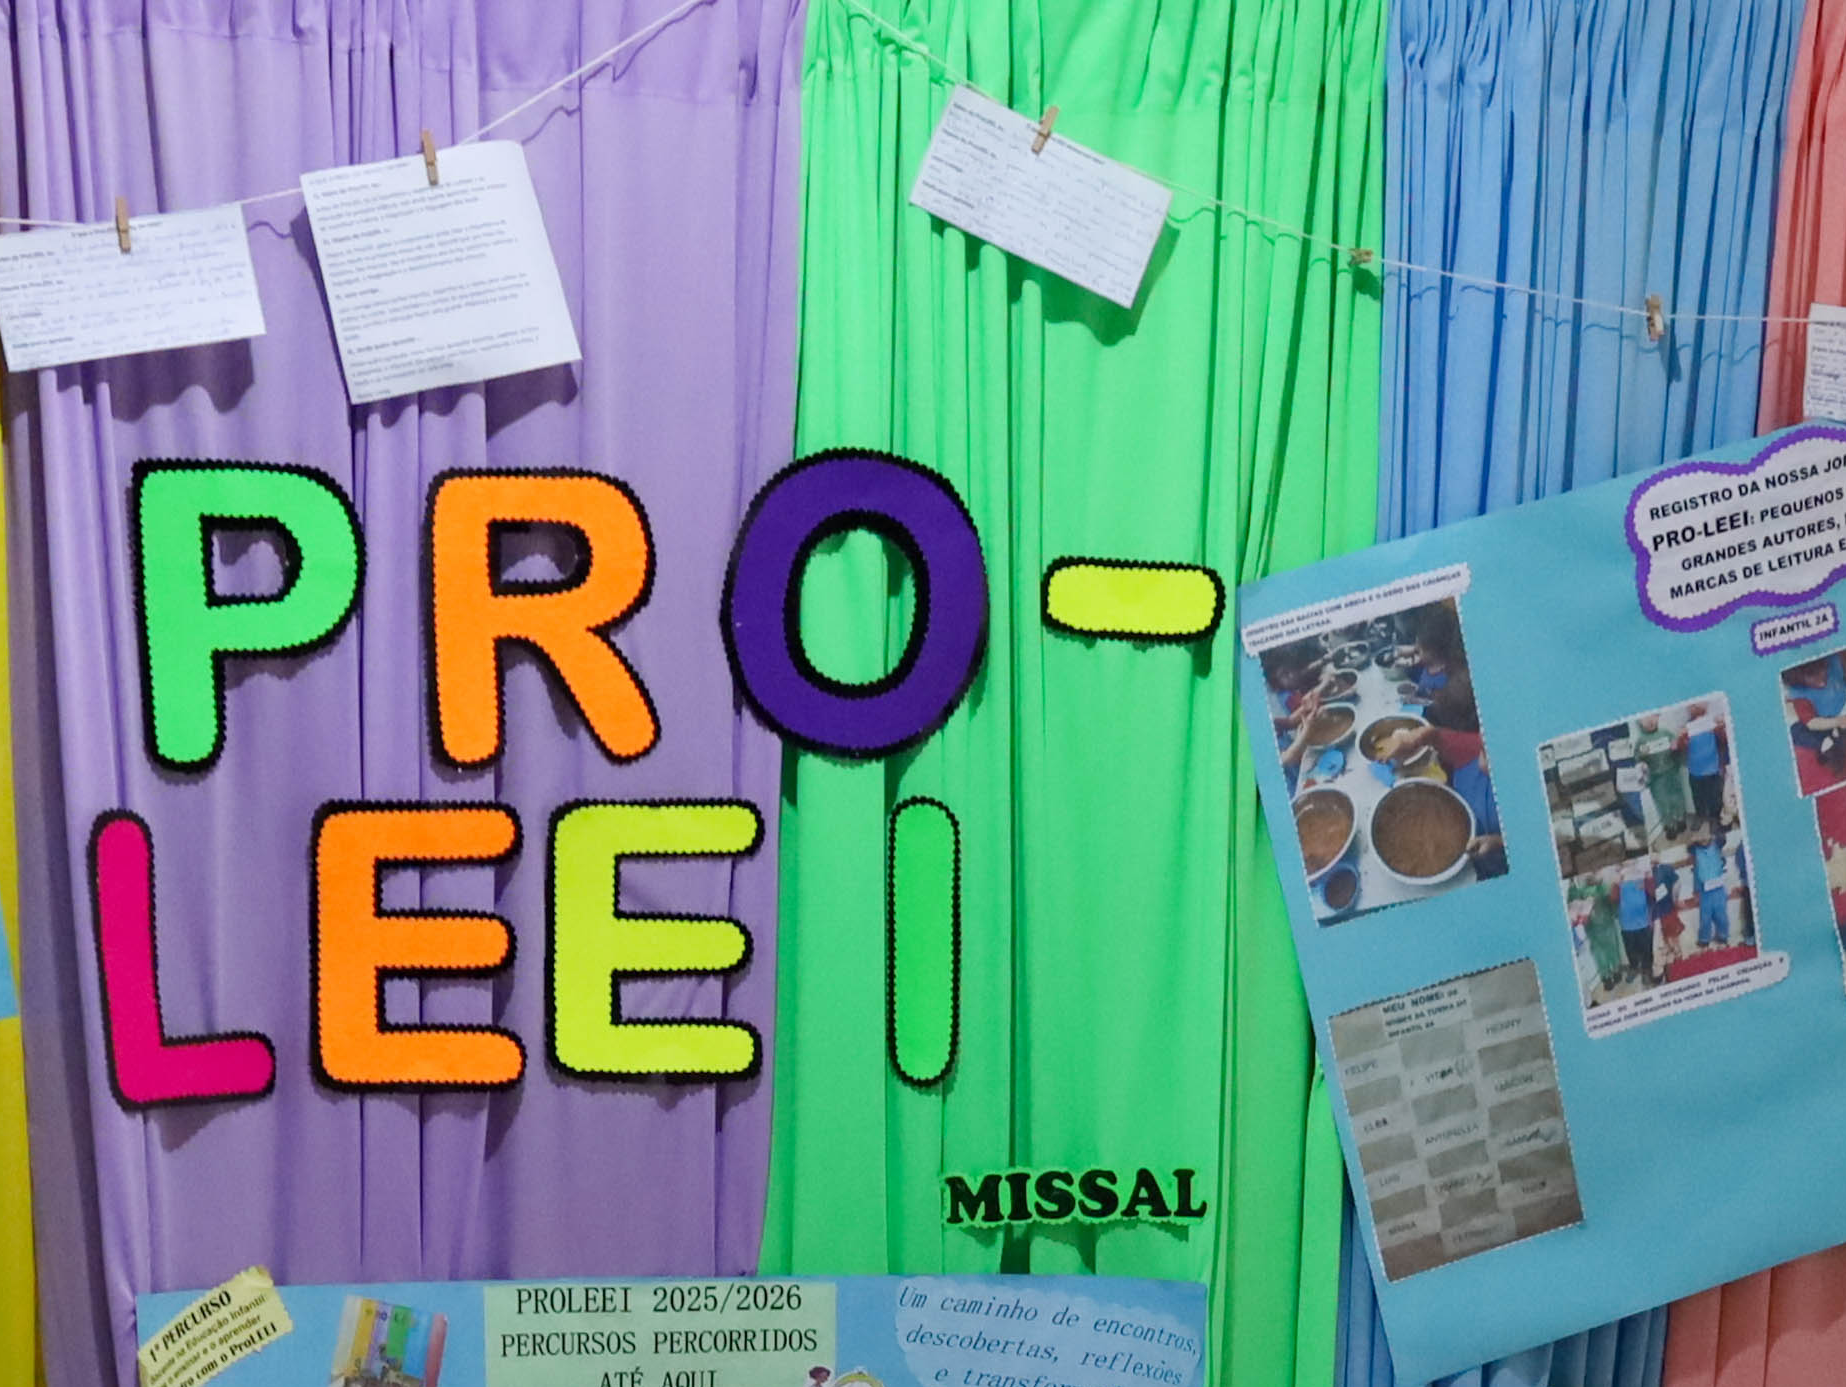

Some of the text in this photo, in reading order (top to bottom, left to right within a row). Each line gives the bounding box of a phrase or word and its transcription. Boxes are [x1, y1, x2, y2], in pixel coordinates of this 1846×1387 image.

[1650, 488, 1733, 521] REGISTRO
[1738, 481, 1761, 498] DA
[1765, 465, 1820, 491] NOSSA
[1652, 510, 1754, 551] PRO-LEEI:
[1759, 487, 1844, 523] PEQUENOS
[1669, 570, 1738, 599] MARCAS
[1742, 562, 1762, 579] DE
[1768, 543, 1835, 572] LEITURA
[1681, 539, 1757, 571] GRANDES
[1762, 516, 1841, 549] AUTORES,
[1759, 614, 1829, 641] INFANTIL 2A
[942, 1168, 1208, 1226] MISSAL
[516, 1282, 802, 1315] PROLEEI 2025/2026
[899, 1285, 1198, 1355] Um caminho de encontros,
[501, 1329, 818, 1357] PERCURSOS PERCORRIDOS
[906, 1324, 1183, 1386] descobertas, reflexões
[934, 1367, 949, 1383] e
